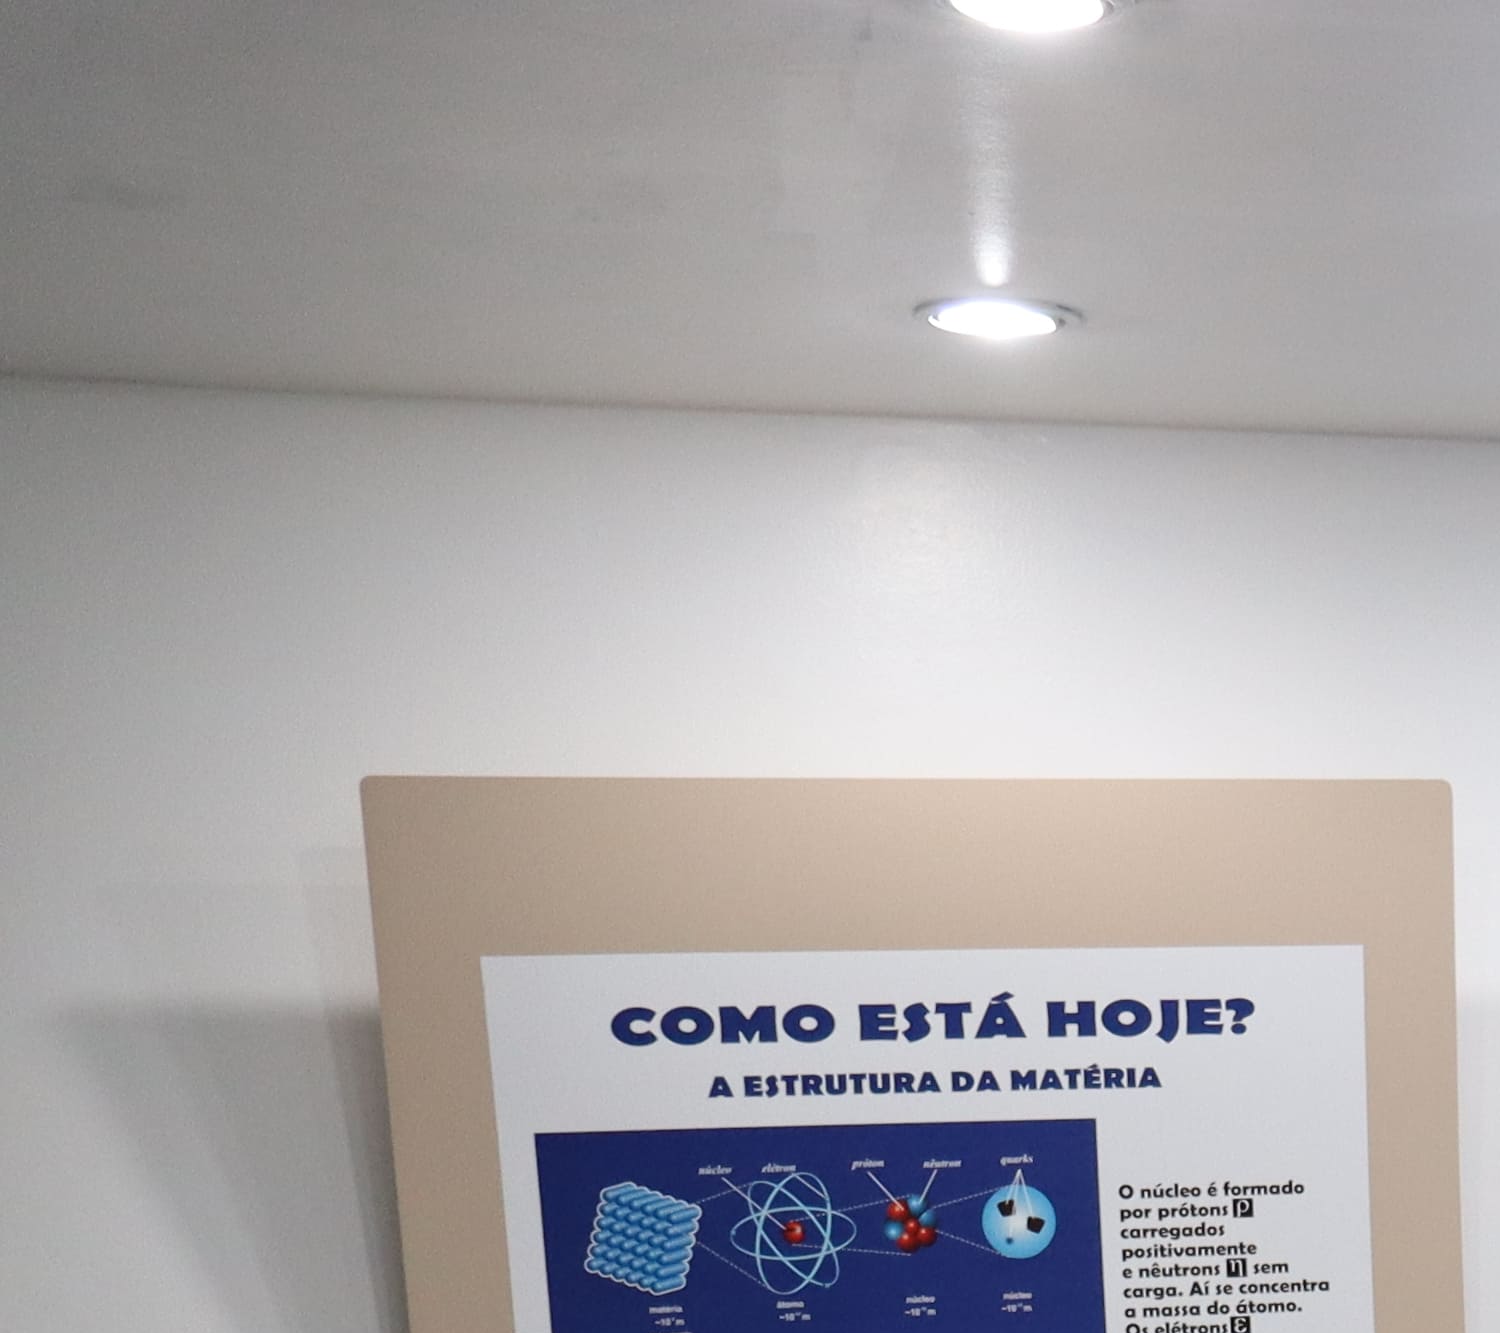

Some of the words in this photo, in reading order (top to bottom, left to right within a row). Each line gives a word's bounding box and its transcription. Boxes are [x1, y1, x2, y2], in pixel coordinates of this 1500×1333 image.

[609, 1003, 835, 1047] COMO
[857, 992, 1026, 1043] ESTÁ
[1045, 997, 1255, 1043] HOJE?
[707, 1075, 734, 1098] A
[742, 1071, 941, 1098] ESTRUTURA
[950, 1069, 1000, 1092] DA
[1009, 1063, 1162, 1091] MATÉRIA
[1118, 1183, 1134, 1200] O
[1140, 1182, 1201, 1199] núcleo
[1206, 1181, 1217, 1197] é
[1222, 1179, 1304, 1196] formado
[1119, 1207, 1151, 1223] por
[1157, 1201, 1228, 1221] prótons
[1119, 1221, 1225, 1240] carregados
[1121, 1241, 1257, 1262] positivamente
[1121, 1267, 1132, 1279] e
[1138, 1262, 1220, 1278] nêutrons
[1253, 1262, 1289, 1275] sem
[1122, 1286, 1183, 1300] carga.
[1189, 1280, 1209, 1296] Aí
[1215, 1283, 1233, 1296] se
[1238, 1278, 1329, 1294] concentra
[1124, 1307, 1136, 1318] a
[1142, 1305, 1200, 1318] massa
[1206, 1299, 1230, 1315] do
[1235, 1298, 1302, 1314] átomo.
